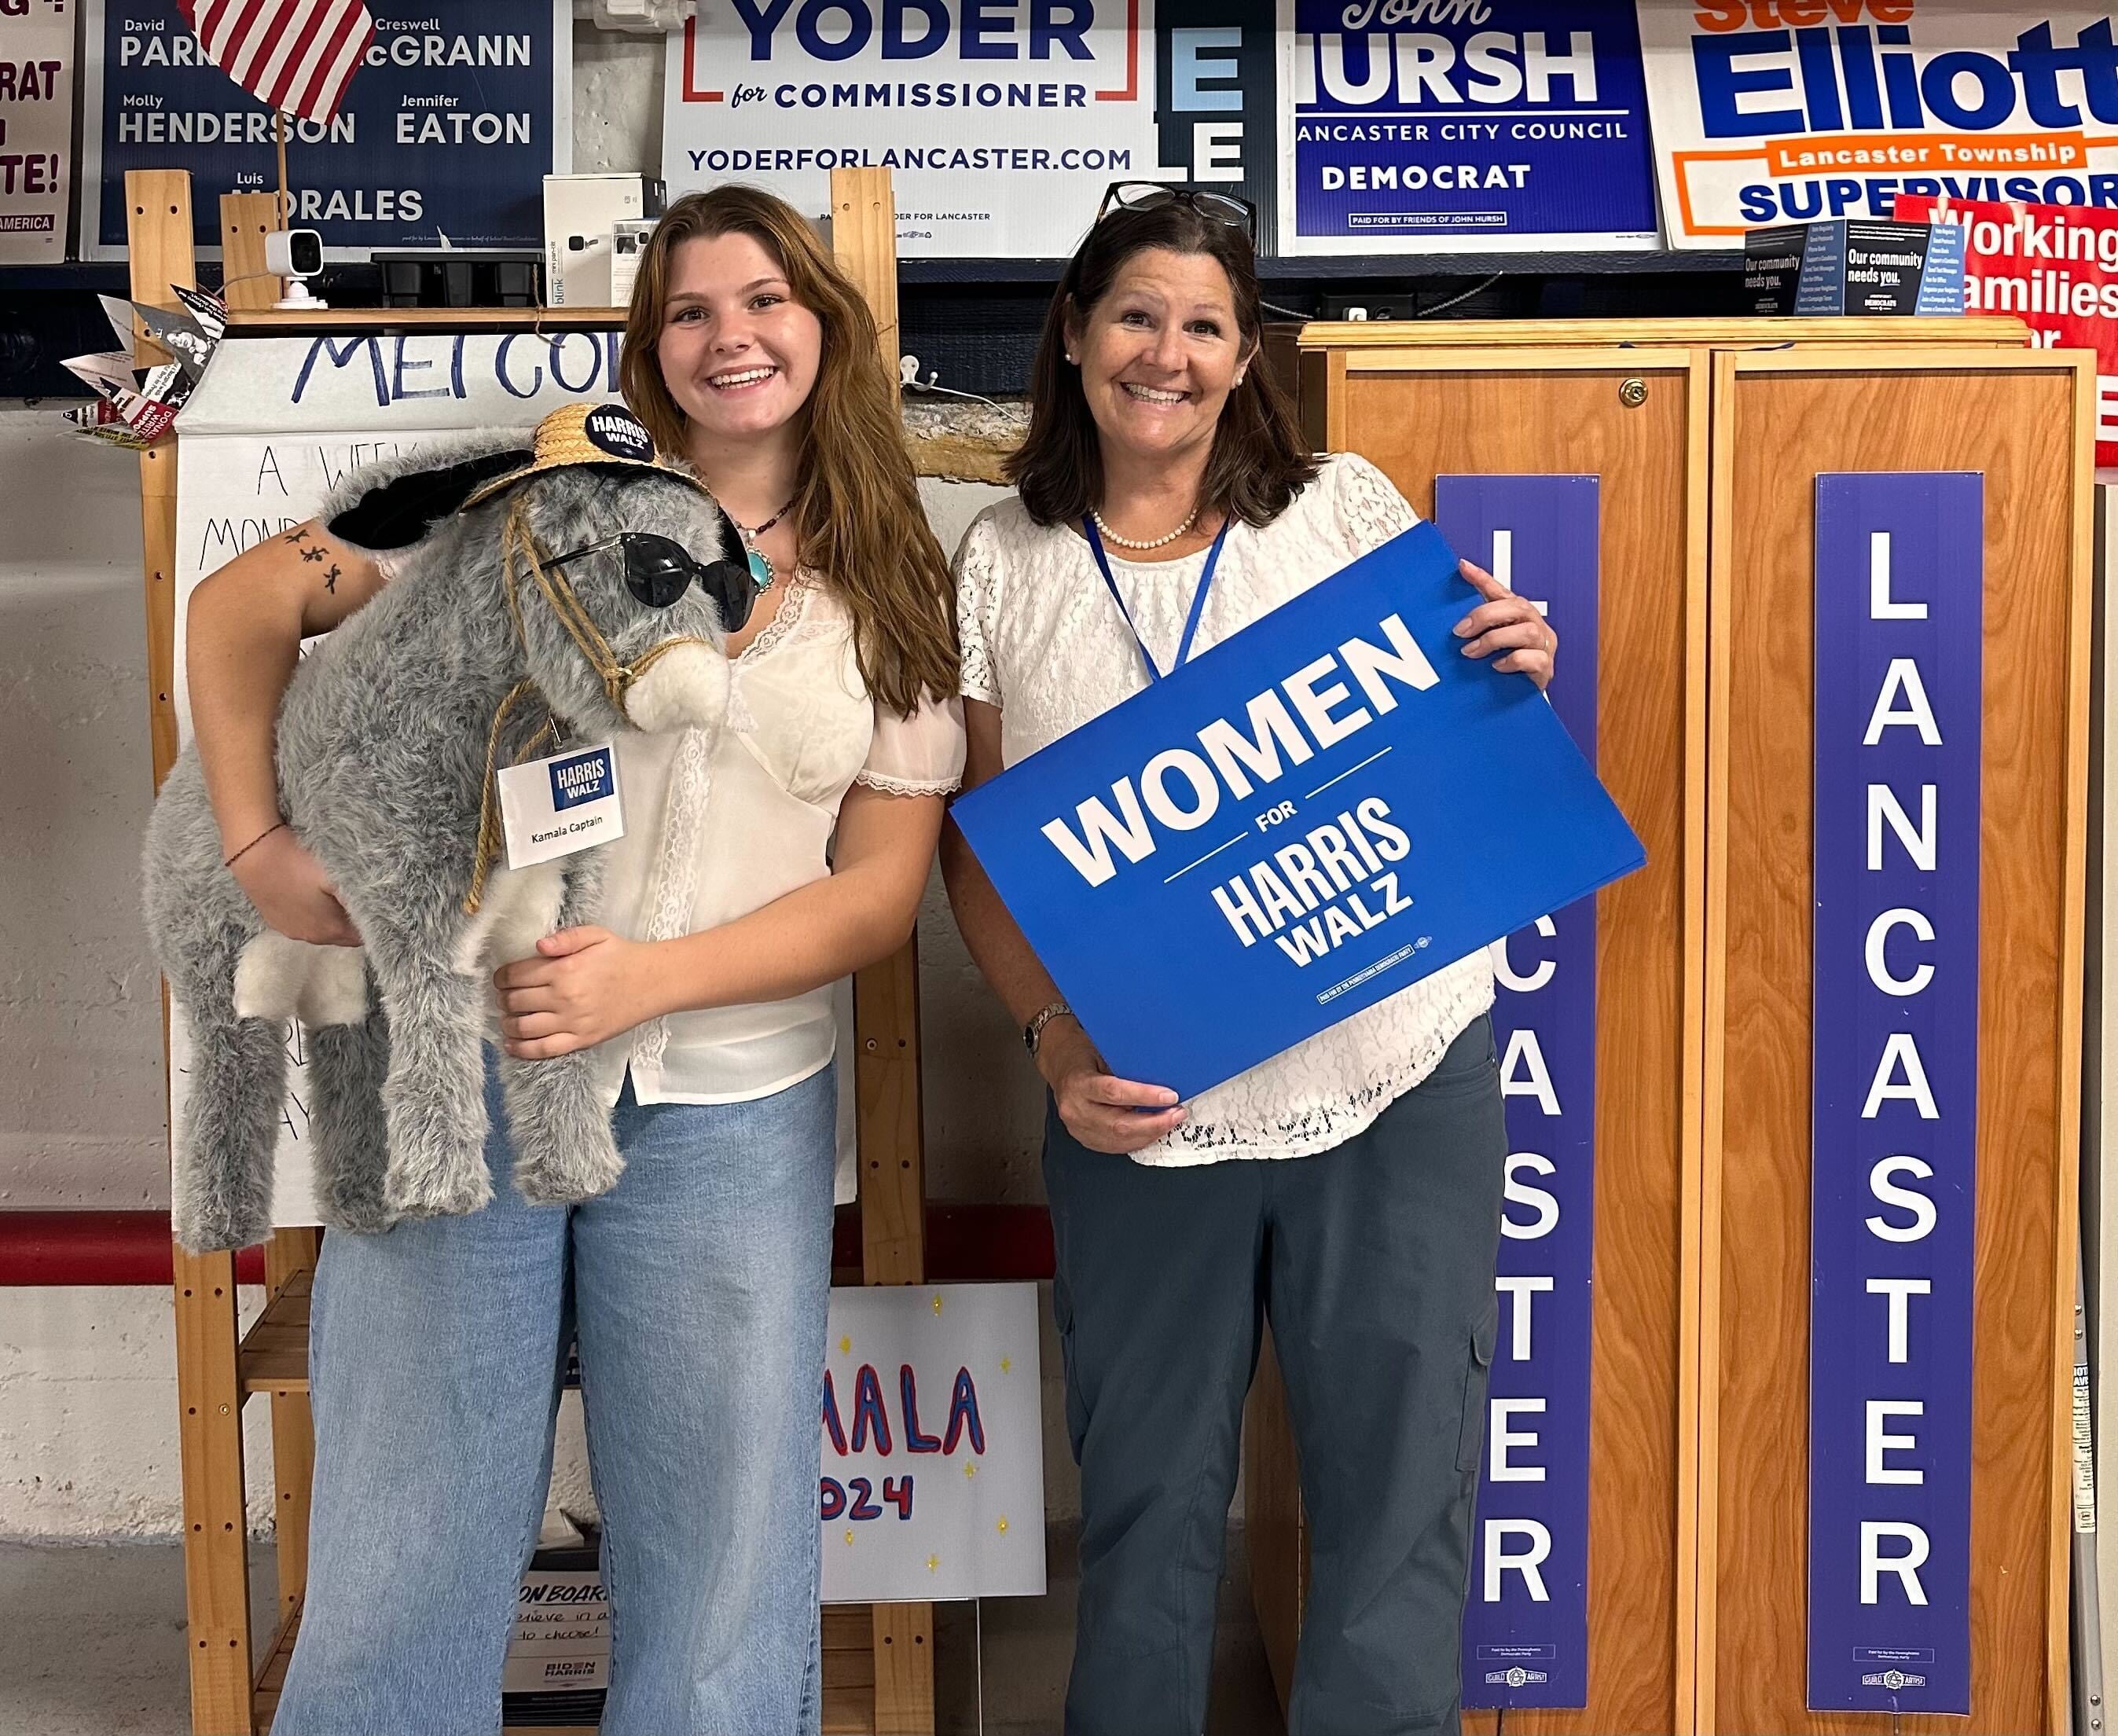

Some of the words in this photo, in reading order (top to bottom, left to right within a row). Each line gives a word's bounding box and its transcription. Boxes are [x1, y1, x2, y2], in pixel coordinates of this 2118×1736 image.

[125, 19, 165, 31] David
[375, 18, 440, 31] Creswell
[730, 0, 1096, 62] YODER
[360, 35, 530, 67] cGRANN
[1295, 31, 1598, 105] URSH
[1691, 17, 2118, 138] Elliott
[123, 94, 163, 109] Molly
[402, 94, 459, 108] Jennifer
[731, 83, 767, 108] for
[774, 83, 1087, 108] COMMISSIONER
[119, 112, 354, 143] HENDERSON
[396, 112, 530, 145] EATON
[1441, 124, 1499, 141] CITY
[1511, 123, 1628, 140] COUNCIL
[688, 149, 1131, 171] YODERFORLANCASTER.COM
[1780, 146, 1928, 168] Lancaster
[1944, 141, 2077, 165] Township
[237, 172, 263, 185] Luis
[1322, 164, 1530, 190] DEMOCRAT
[1745, 258, 1758, 272] Our
[1759, 254, 1800, 270] community
[1848, 249, 1868, 265] Our
[1870, 251, 1922, 270] community
[1745, 273, 1765, 288] needs
[1766, 276, 1782, 289] you.
[1848, 267, 1878, 283] needs
[1880, 271, 1900, 286] you.
[555, 278, 563, 304] blink
[592, 417, 648, 443] HARRIS
[606, 432, 644, 450] WALZ
[258, 446, 288, 496] A
[1041, 612, 1441, 888] WOMEN
[557, 758, 605, 789] HARRIS
[567, 780, 600, 799] WALZ
[1254, 799, 1298, 833] FOR
[531, 827, 567, 843] Kamala
[569, 816, 603, 833] Captain
[1210, 797, 1411, 948] HARRIS
[1274, 872, 1414, 968] WALZ
[1858, 530, 1942, 1607] LANCASTER
[545, 1585, 608, 1602] BOAR
[577, 1612, 591, 1620] in
[545, 1627, 599, 1640] choose!
